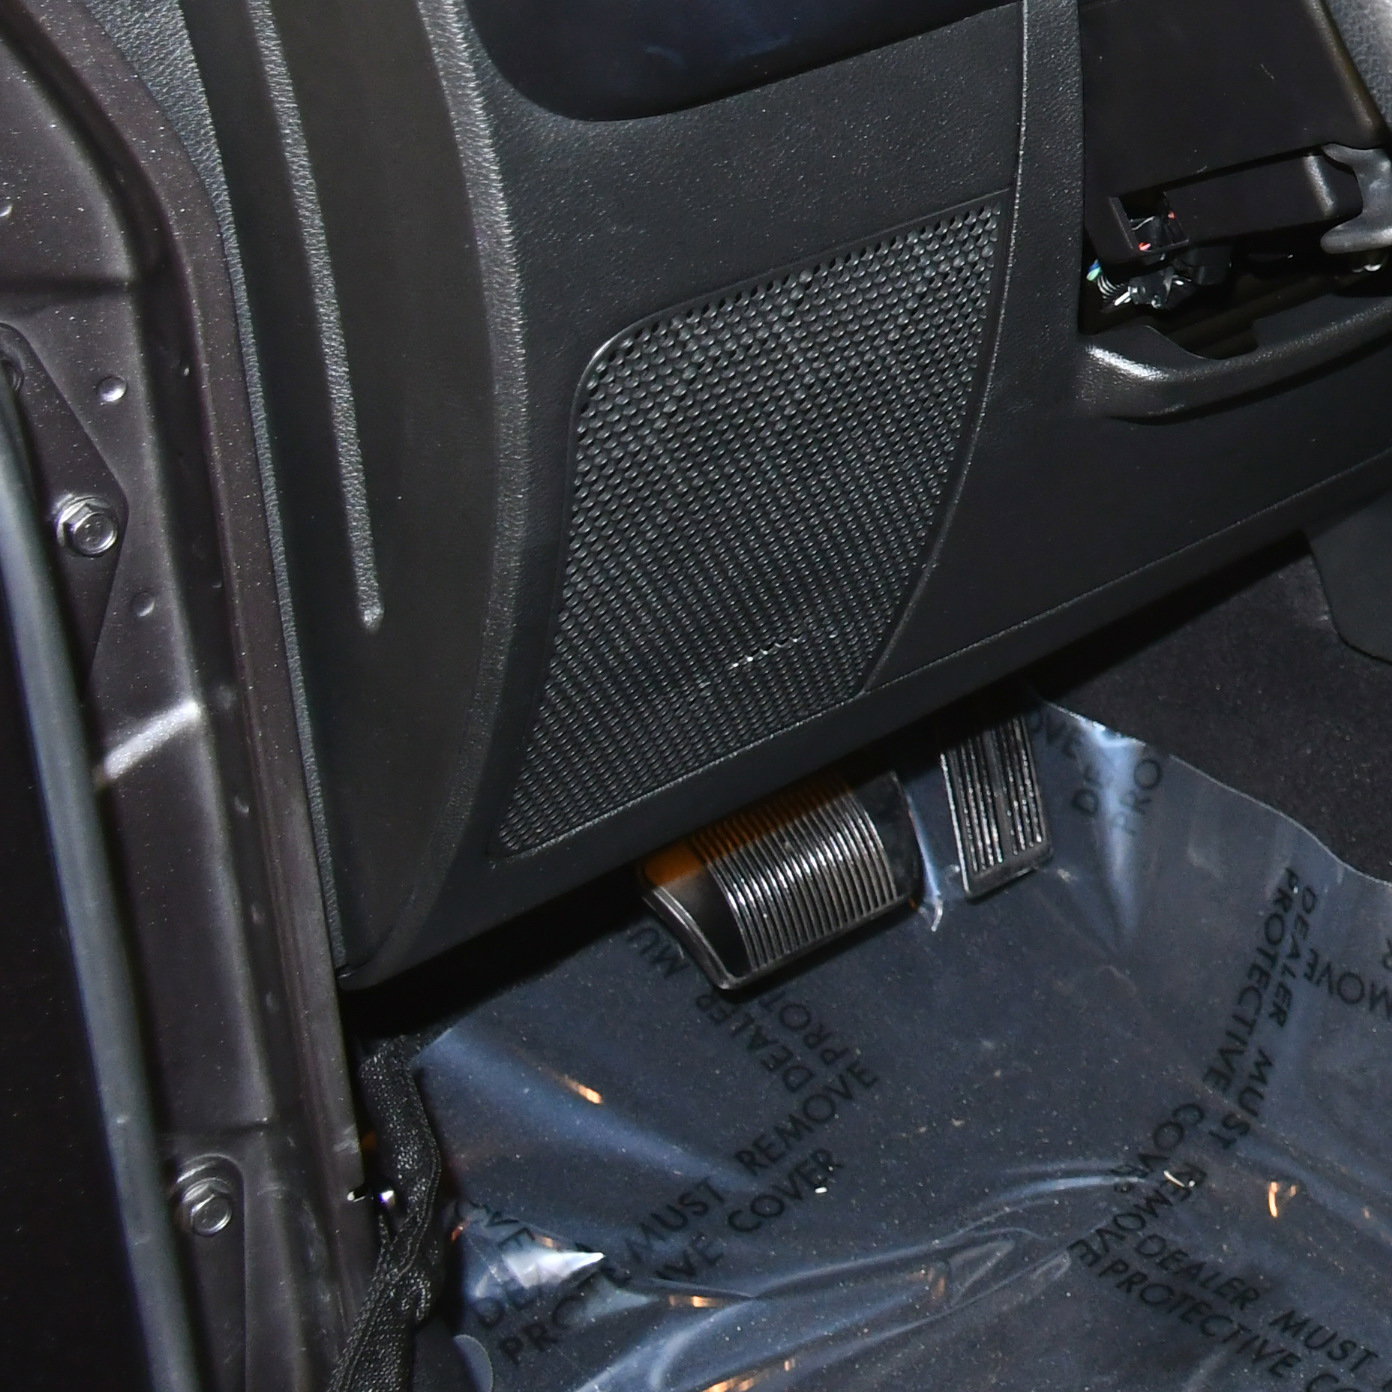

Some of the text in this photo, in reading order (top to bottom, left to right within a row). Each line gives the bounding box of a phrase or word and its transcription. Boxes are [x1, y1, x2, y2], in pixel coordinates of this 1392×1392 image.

[1203, 867, 1298, 1094] PROTECTIVE
[625, 1176, 725, 1263] MUST
[734, 1060, 879, 1176] REMOVE
[1209, 1048, 1274, 1149] MUST
[727, 1149, 844, 1233] COVER
[1099, 1259, 1302, 1378] PROTECTIVE
[1134, 1234, 1379, 1372] DEALER MUST
